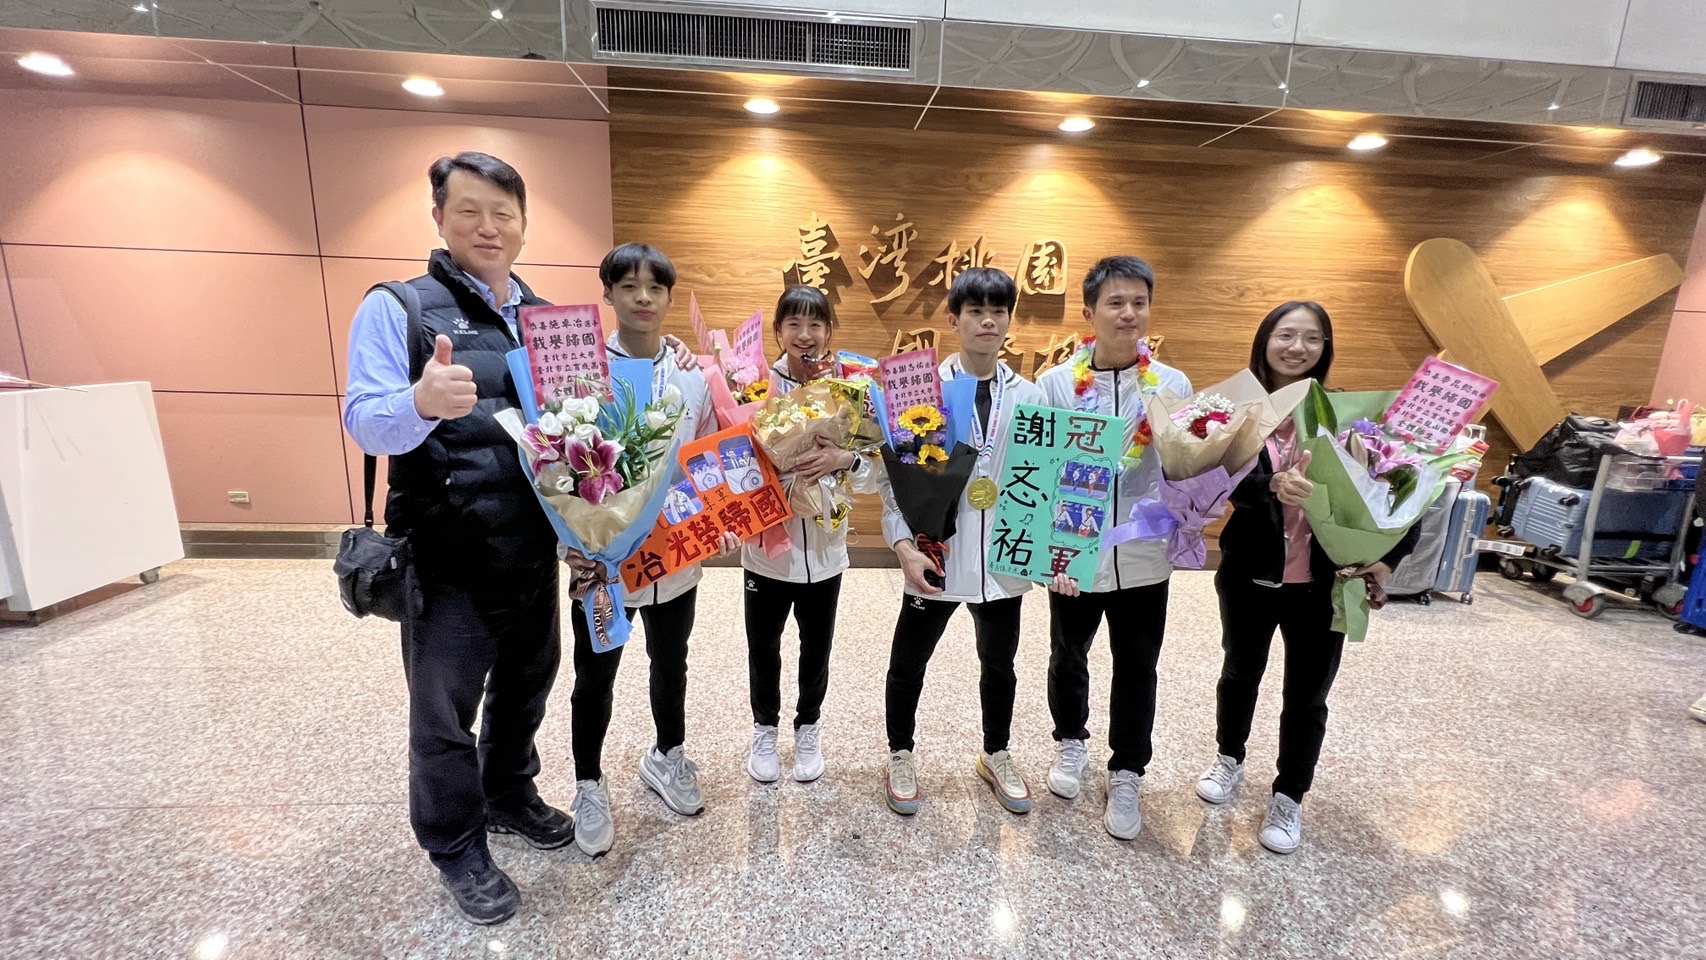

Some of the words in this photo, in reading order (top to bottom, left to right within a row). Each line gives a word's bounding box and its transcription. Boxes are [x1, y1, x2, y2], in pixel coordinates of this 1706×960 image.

[532, 332, 596, 350] 載譽歸國
[542, 350, 596, 363] 臺北市立大學
[887, 372, 934, 391] 載譽歸國
[894, 387, 933, 400] 臺北市立大學
[1414, 379, 1473, 410] 載譽歸國
[1412, 394, 1461, 418] 臺北市立大學
[1397, 420, 1434, 441] 全體師生
